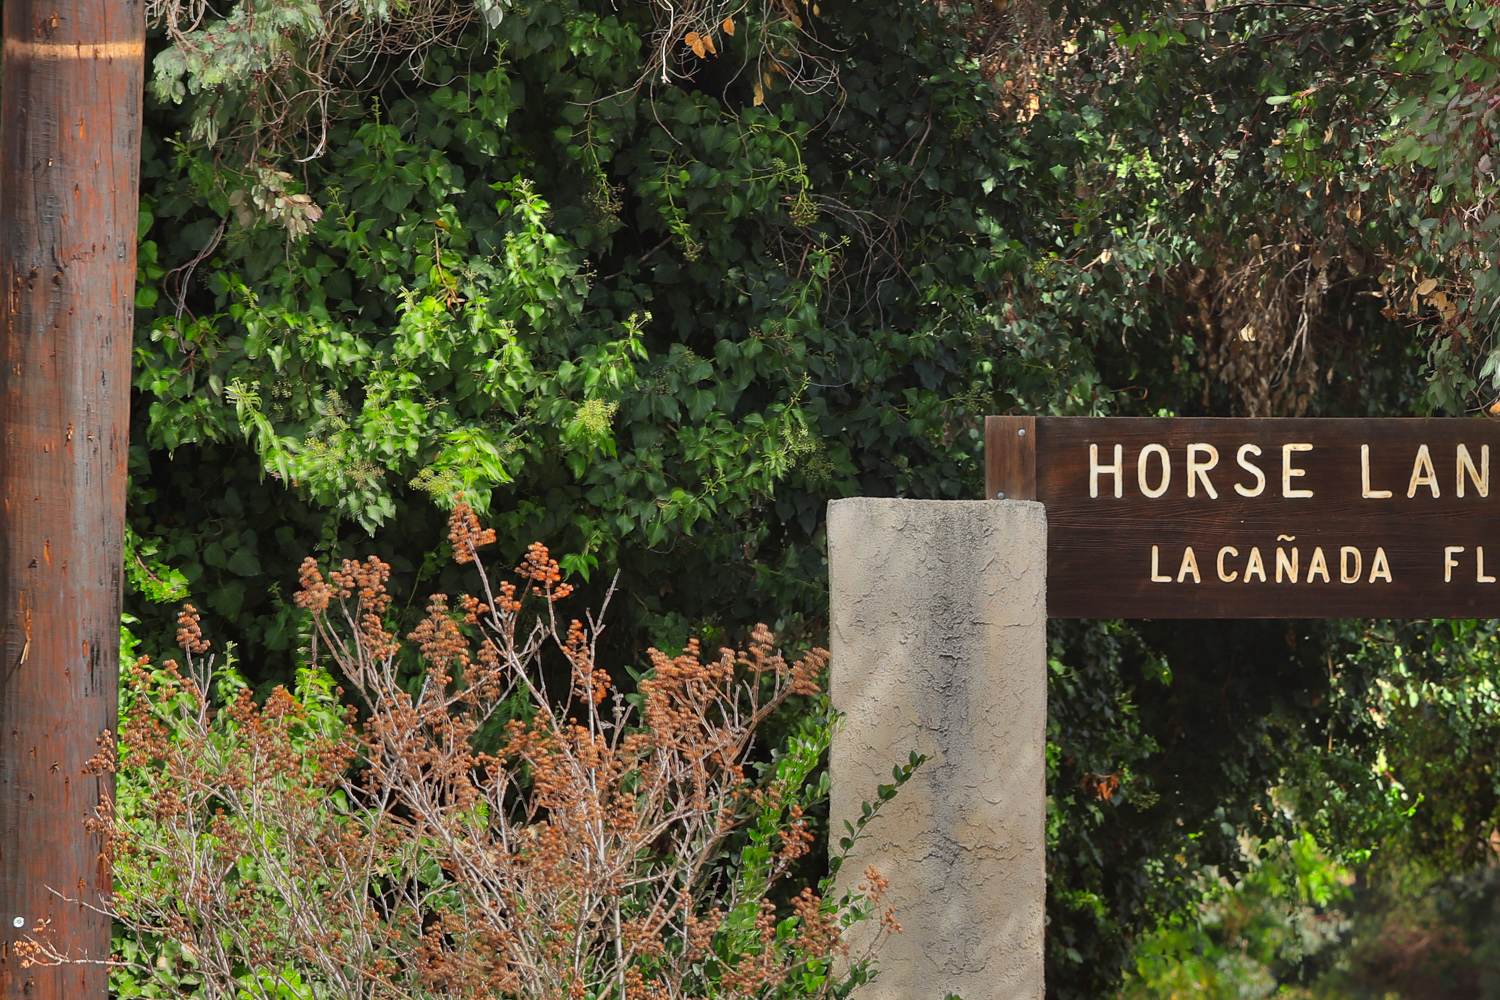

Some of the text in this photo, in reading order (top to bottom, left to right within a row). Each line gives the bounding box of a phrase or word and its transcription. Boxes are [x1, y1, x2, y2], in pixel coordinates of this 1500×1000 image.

[1088, 442, 1314, 499] HORSE
[1150, 545, 1203, 584] LA
[1216, 534, 1394, 584] CAÑADA
